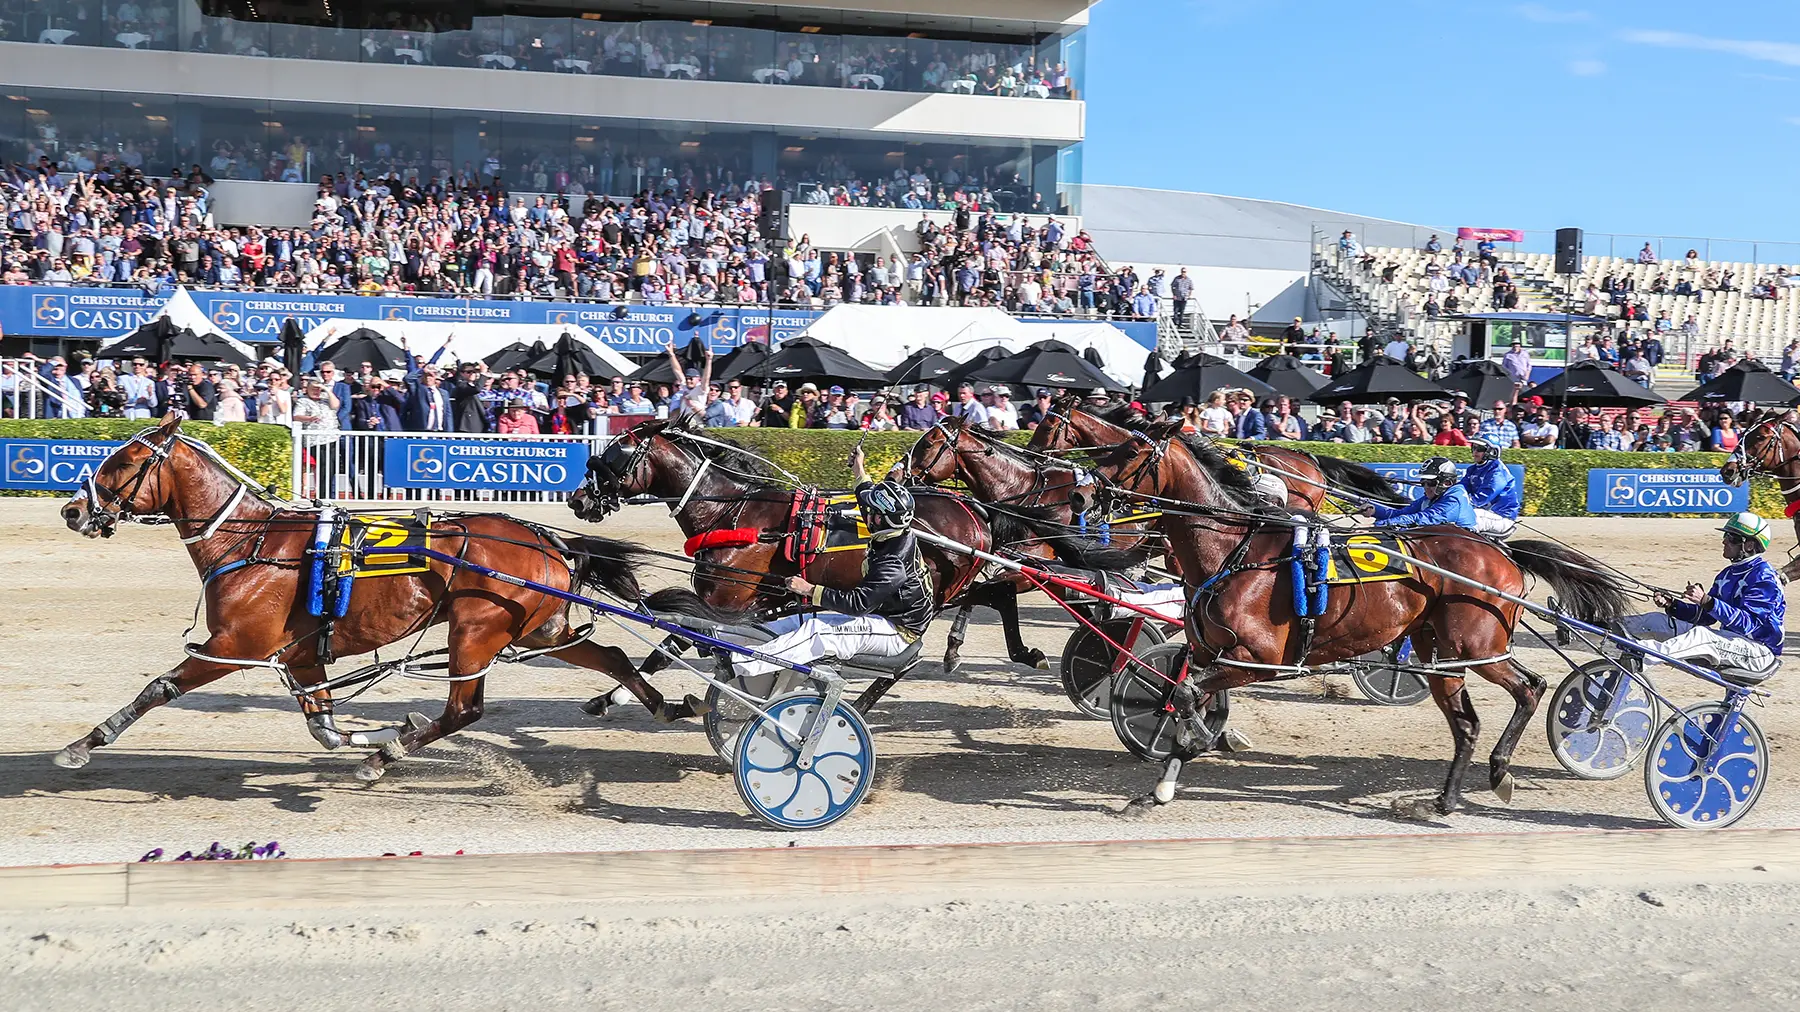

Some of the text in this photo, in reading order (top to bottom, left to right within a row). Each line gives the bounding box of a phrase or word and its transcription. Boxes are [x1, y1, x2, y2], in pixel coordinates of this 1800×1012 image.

[245, 300, 345, 313] CHRISTCHURCH
[414, 305, 511, 318] CHRISTCHURCH
[69, 310, 154, 330] CASIN
[580, 310, 674, 323] CHRISCHURCH
[448, 445, 567, 458] CHRISTCHURCH
[447, 462, 567, 485] CASINO
[1638, 473, 1723, 484] CHRISTCHURC
[1637, 488, 1734, 507] CASINO
[363, 519, 410, 566] 2
[1346, 535, 1390, 573] 6
